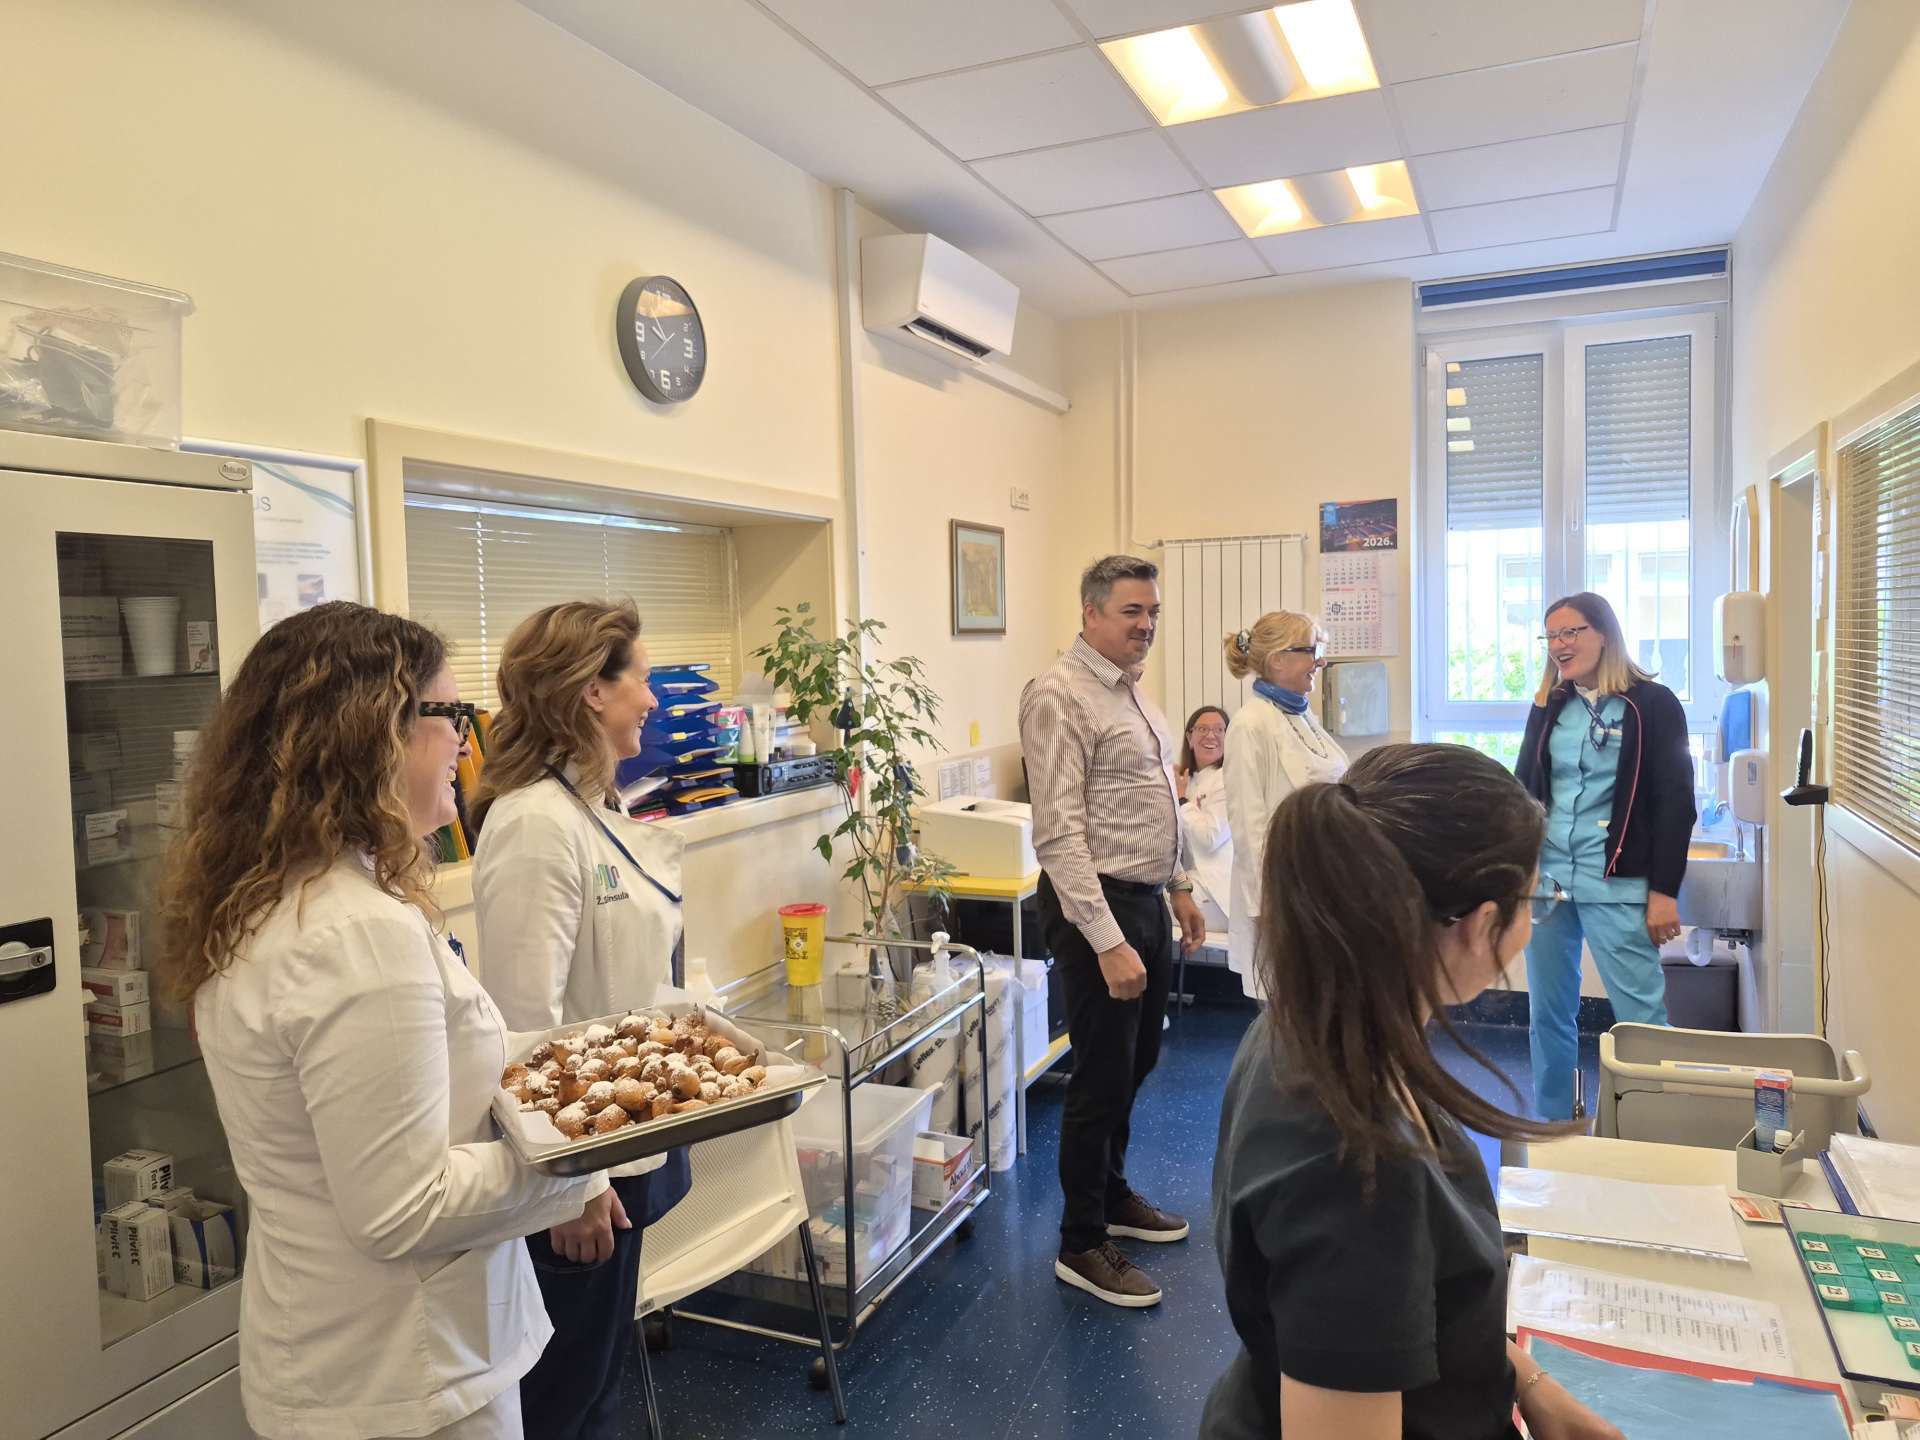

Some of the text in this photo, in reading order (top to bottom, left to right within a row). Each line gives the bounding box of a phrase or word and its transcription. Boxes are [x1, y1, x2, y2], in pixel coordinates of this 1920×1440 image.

[635, 320, 645, 343] 9
[683, 338, 694, 359] 3
[660, 368, 671, 391] 6
[1363, 536, 1394, 547] 2026.
[159, 1163, 172, 1194] Pliv
